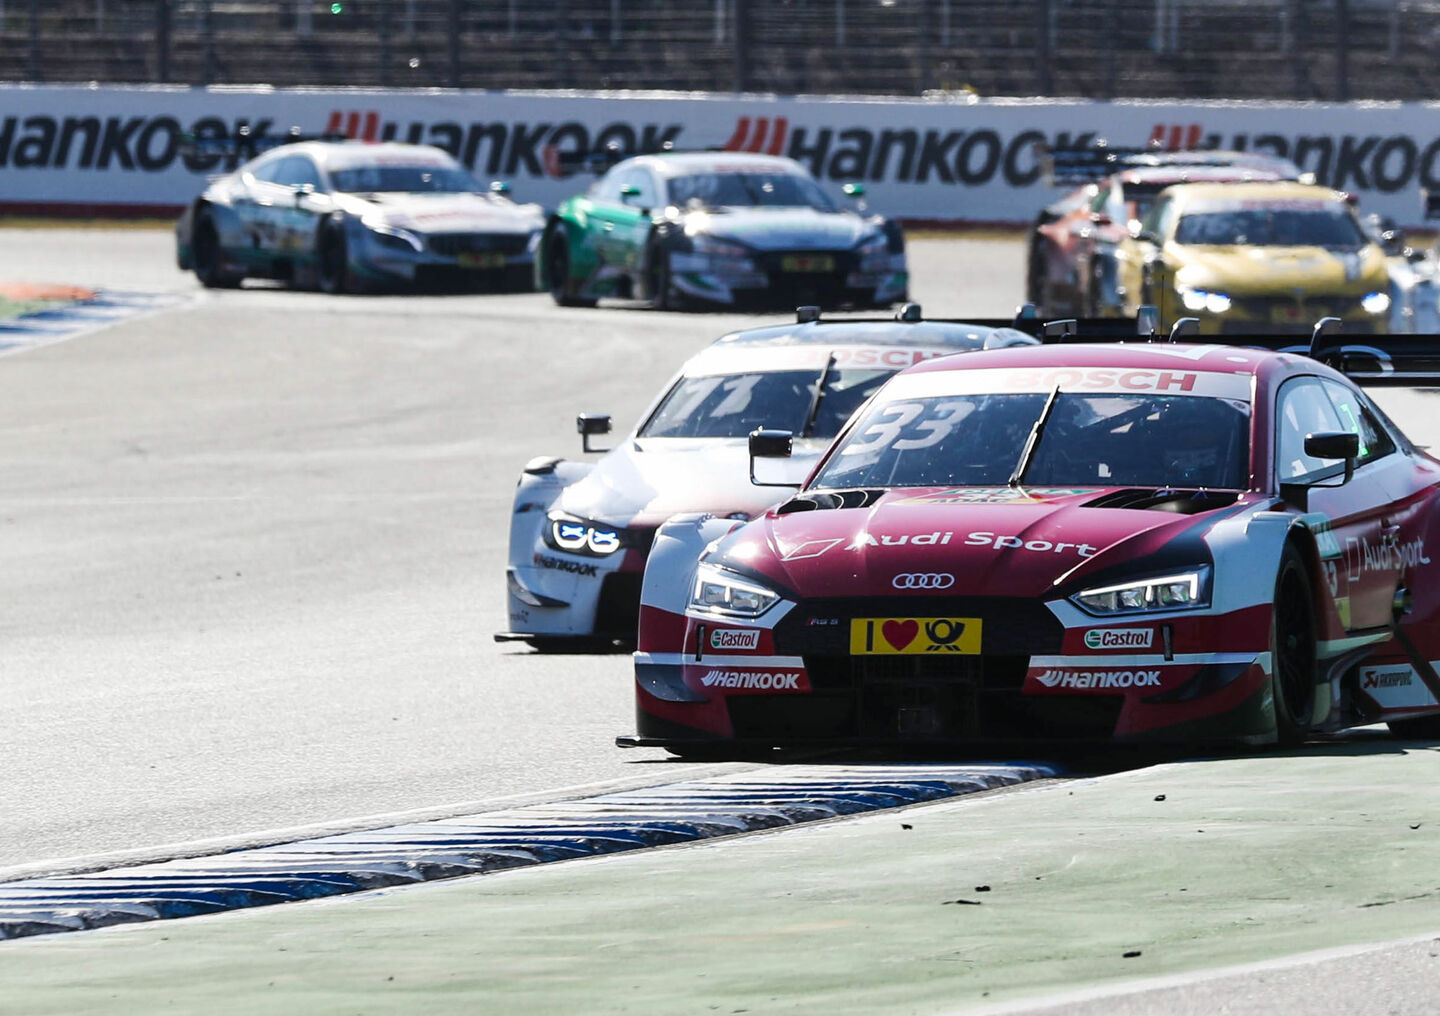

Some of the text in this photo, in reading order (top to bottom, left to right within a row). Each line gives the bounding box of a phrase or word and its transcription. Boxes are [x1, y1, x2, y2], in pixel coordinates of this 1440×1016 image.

[1005, 369, 1197, 392] BOSCH
[841, 401, 976, 456] 33
[843, 530, 1099, 558] Audi Sport
[1362, 534, 1393, 571] Audi
[720, 631, 756, 647] Castrol
[1101, 630, 1149, 646] Castrol
